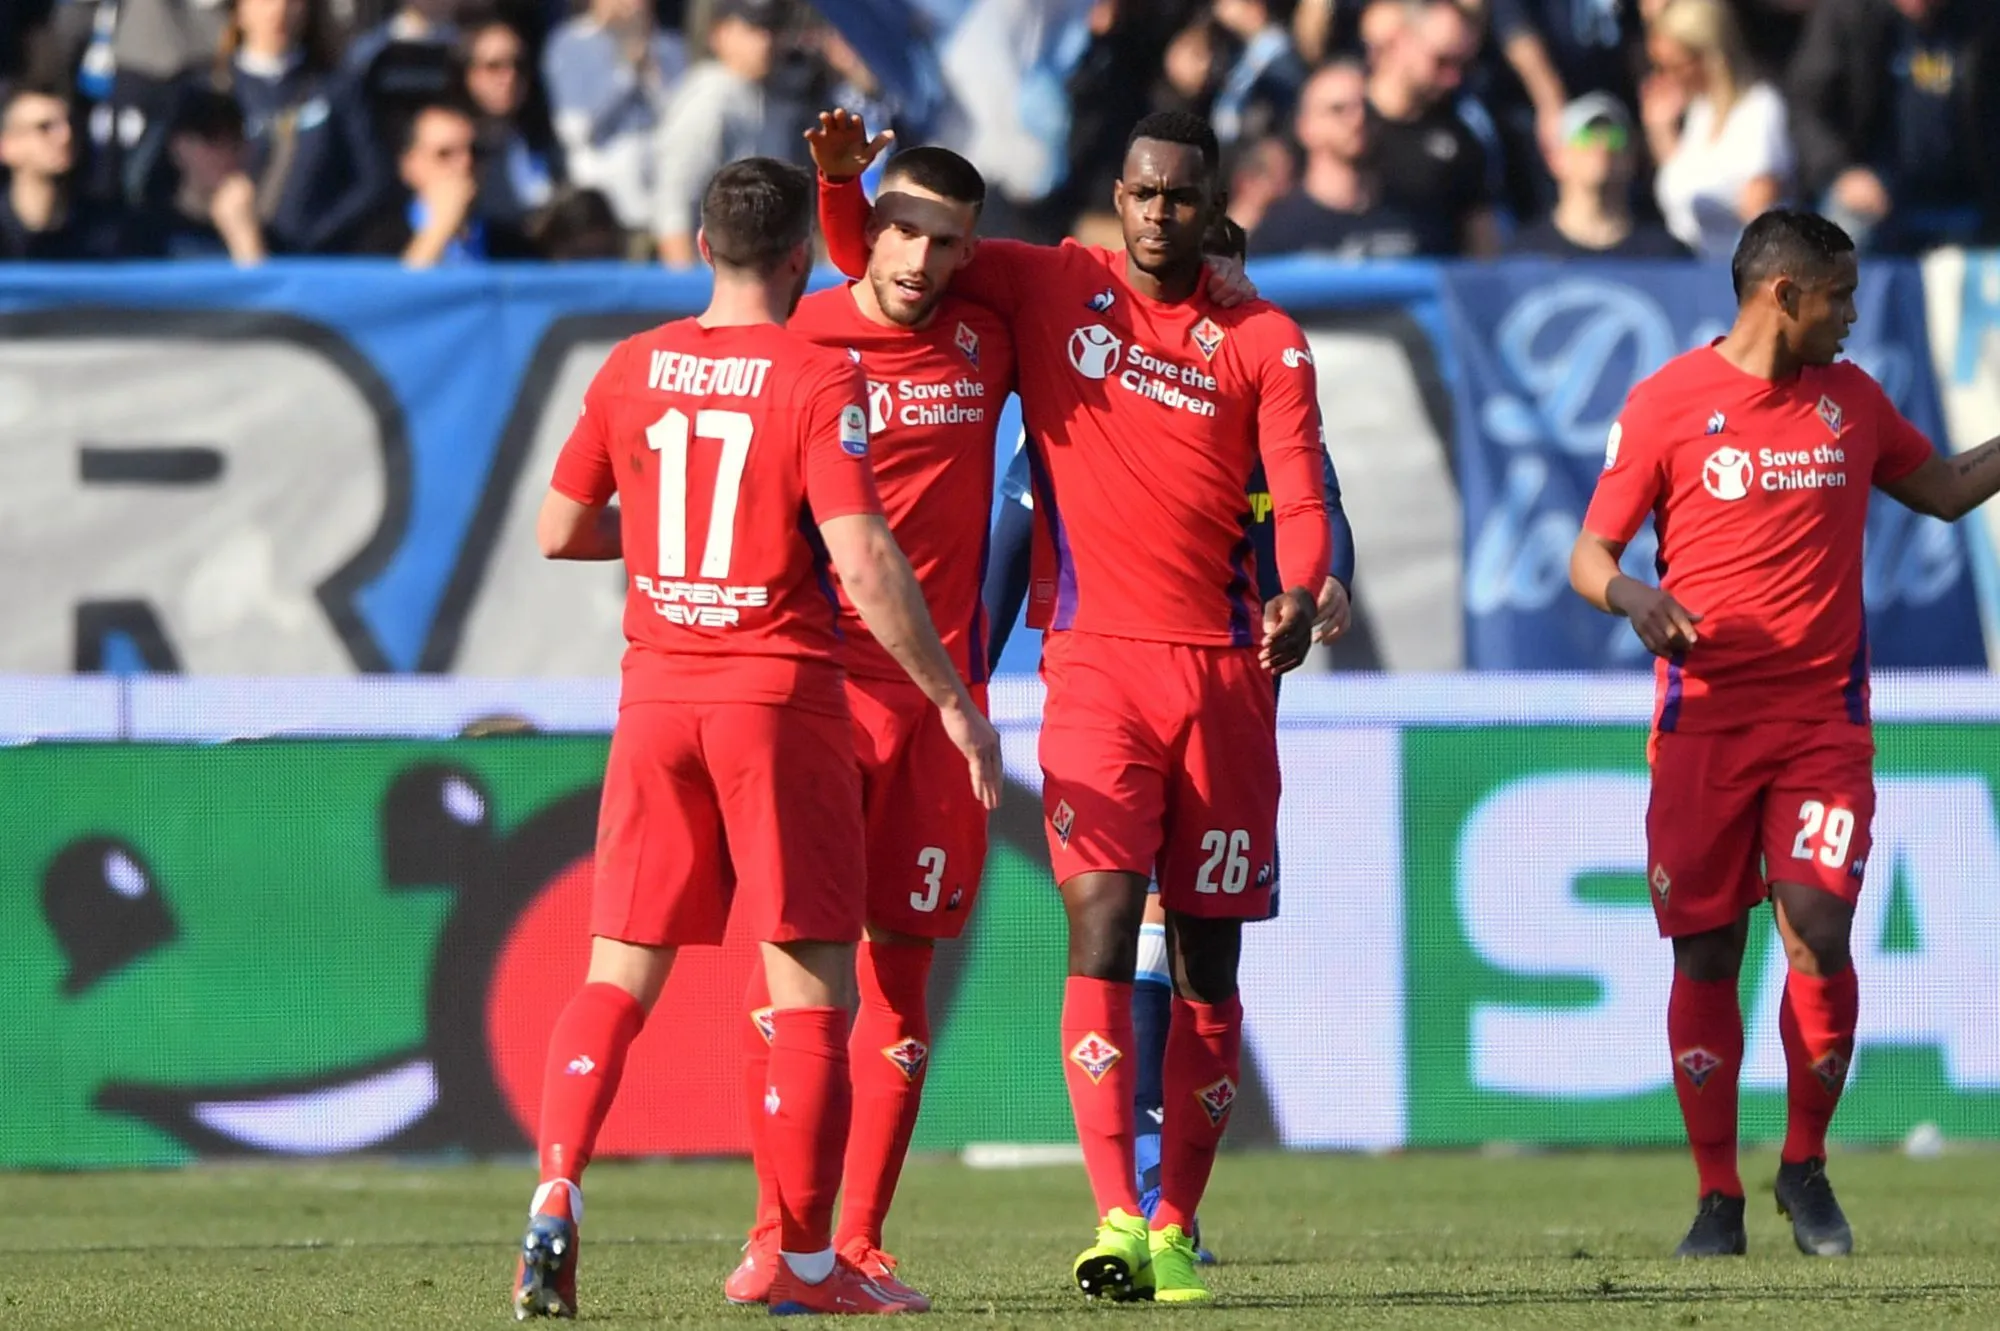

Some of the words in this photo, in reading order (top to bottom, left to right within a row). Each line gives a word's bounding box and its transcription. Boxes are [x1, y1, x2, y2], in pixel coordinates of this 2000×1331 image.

[646, 348, 773, 399] VERETOUT
[897, 378, 952, 401] Save
[954, 376, 985, 397] the
[1126, 344, 1179, 379] Save
[1180, 366, 1217, 391] the
[899, 402, 985, 426] Children
[1119, 369, 1217, 417] Children
[1758, 447, 1811, 468] Save
[1813, 443, 1846, 465] the
[644, 406, 755, 579] 17
[1759, 467, 1848, 492] Children
[634, 574, 768, 607] FLORENCE
[653, 602, 740, 628] 4EVER
[1791, 800, 1855, 869] 29
[910, 847, 946, 912] 3
[1196, 829, 1250, 894] 26
